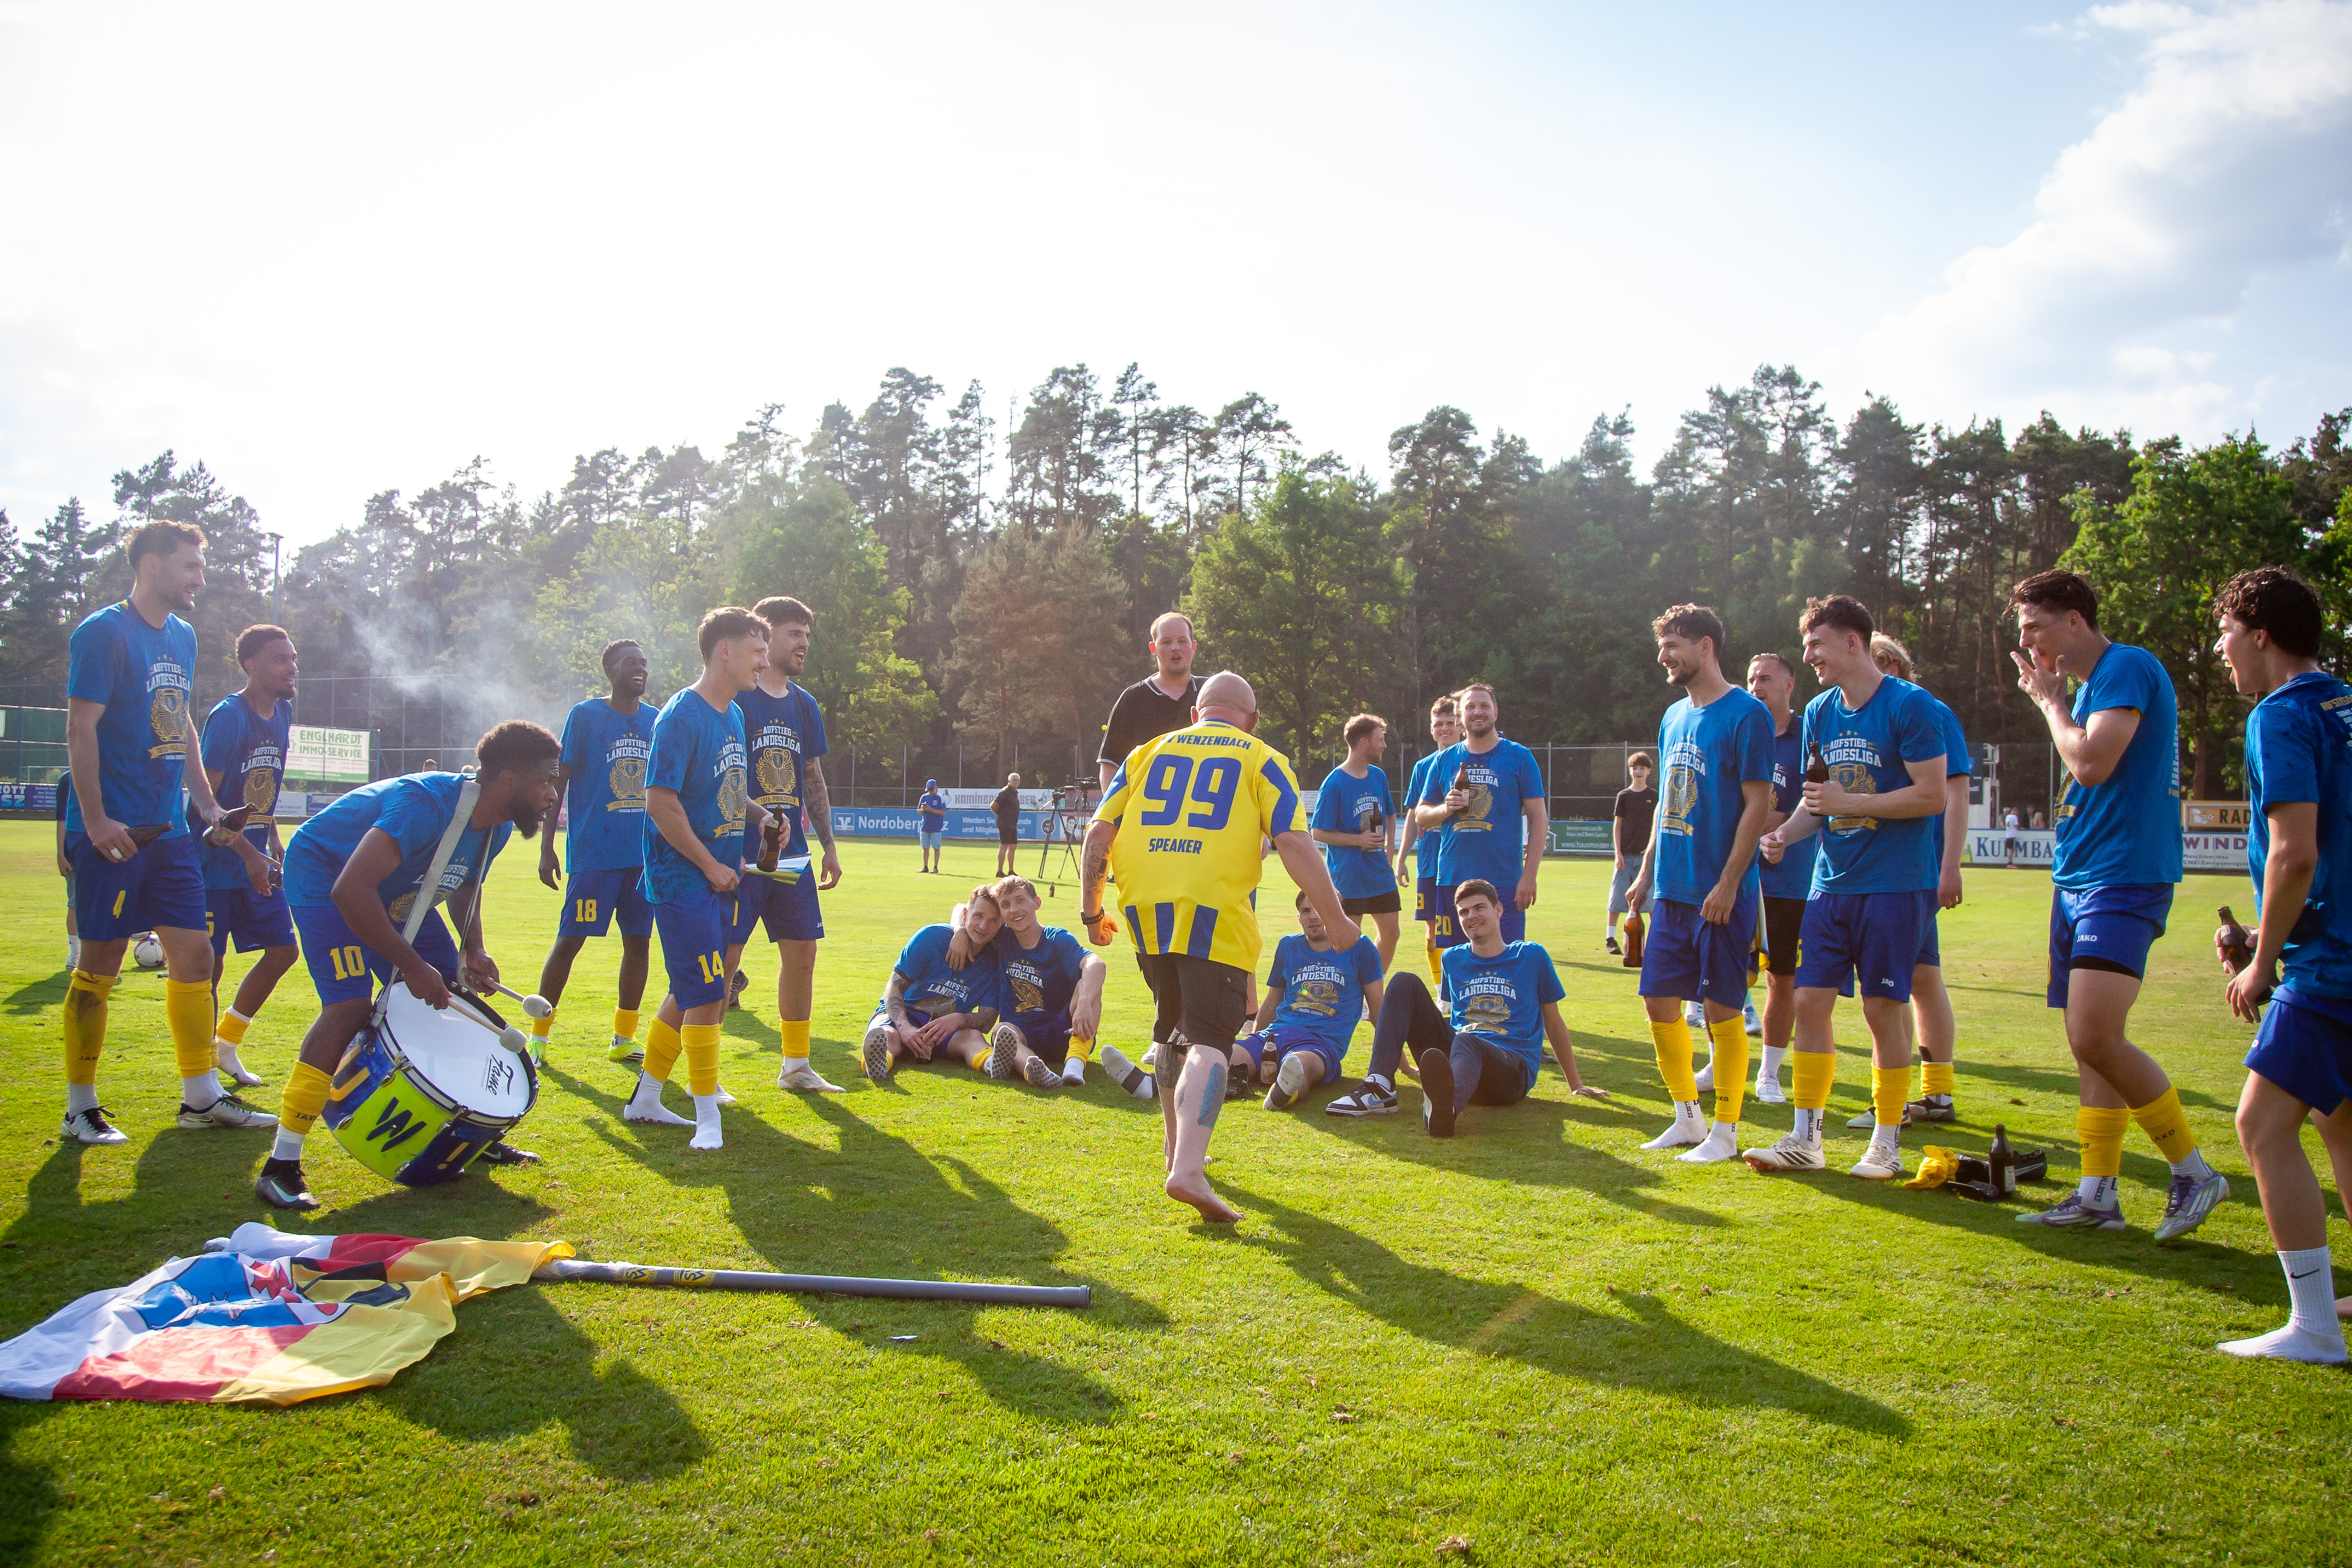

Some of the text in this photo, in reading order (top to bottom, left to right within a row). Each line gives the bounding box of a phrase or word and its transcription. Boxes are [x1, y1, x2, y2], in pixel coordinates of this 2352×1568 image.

[763, 726, 792, 736] AUFSTIEG
[616, 739, 647, 748] AUFSTIEG
[752, 735, 801, 754] LANDESLIGA
[1177, 734, 1252, 750] WENZENBACH
[1829, 737, 1867, 750] AUFSTIEG
[299, 745, 362, 758] IMMO-SERVICE
[1823, 748, 1882, 767] ANDESLIGA
[0, 785, 26, 794] OTT
[1141, 753, 1242, 831] 99
[1148, 838, 1203, 855] SPEAKER
[2183, 837, 2247, 850] WIND
[576, 899, 597, 922] 18
[1436, 915, 1452, 936] 20
[2077, 934, 2097, 942] JAKO
[330, 946, 365, 981] 10
[698, 950, 725, 984] 14
[1292, 972, 1345, 987] LANDESLIGA
[1469, 976, 1506, 984] AUFSTIEG
[1459, 984, 1517, 1001] LANDESLIGA
